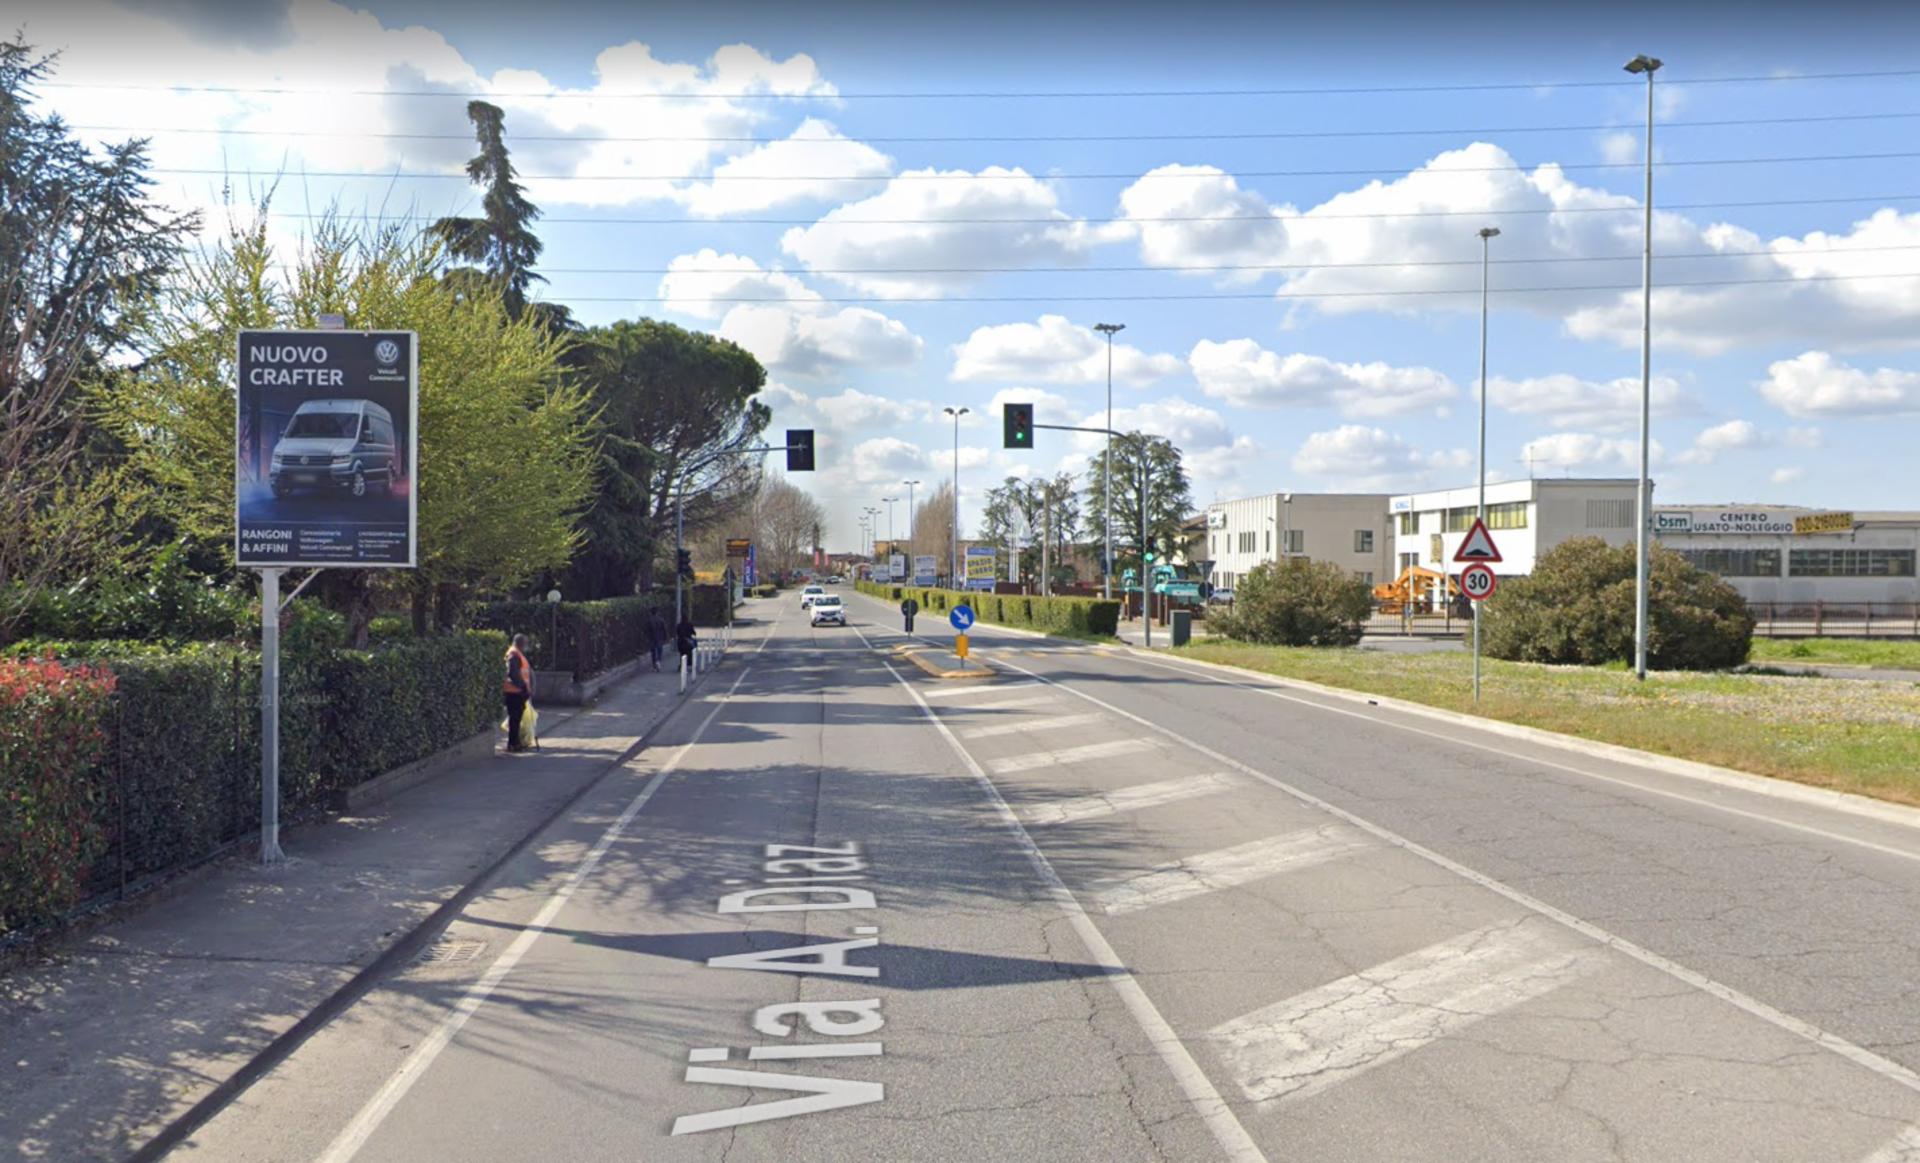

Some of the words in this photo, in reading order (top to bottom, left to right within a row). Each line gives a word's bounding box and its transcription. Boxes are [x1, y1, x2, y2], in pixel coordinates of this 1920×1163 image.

[249, 346, 328, 363] NUOVO
[249, 368, 344, 386] CRAFTER
[1658, 514, 1688, 528] bsm
[1719, 513, 1768, 522] CENTRO
[1694, 522, 1793, 532] USATO-NOLEGGIO
[241, 529, 292, 540] RANGONI
[241, 543, 250, 553] &
[252, 543, 289, 553] AFFINI
[1467, 572, 1488, 590] 30
